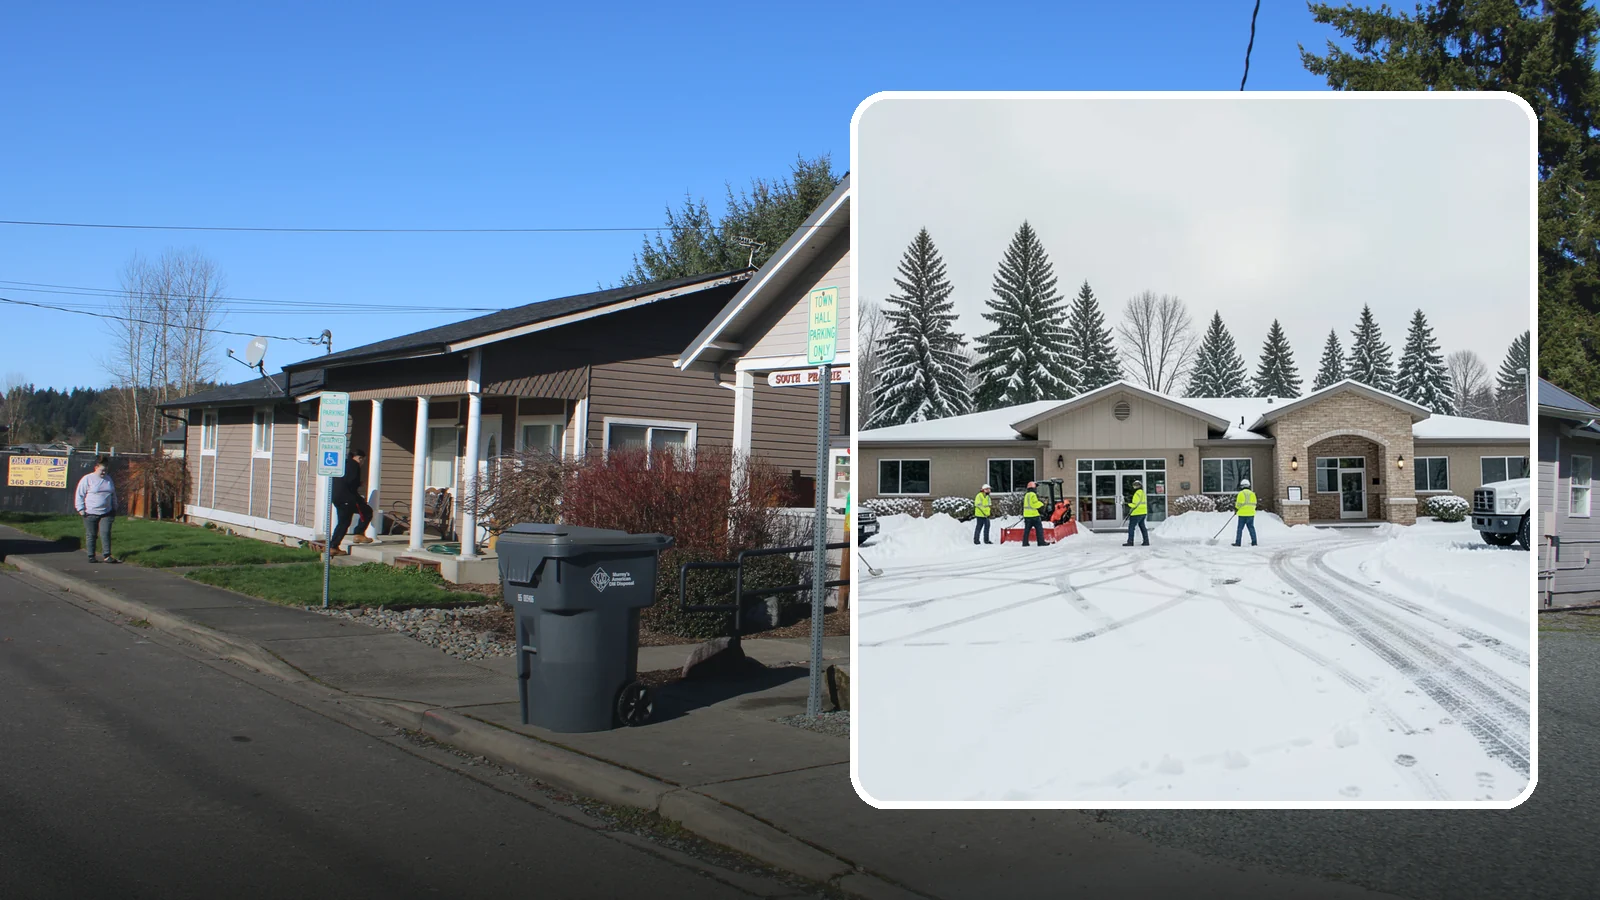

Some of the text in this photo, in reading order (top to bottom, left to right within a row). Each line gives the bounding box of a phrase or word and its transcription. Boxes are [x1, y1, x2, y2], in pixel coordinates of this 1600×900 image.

[815, 295, 833, 308] TOWN
[814, 312, 832, 324] HALL
[810, 327, 836, 341] PARKING
[813, 344, 831, 357] ONLY
[775, 373, 801, 384] SOUTH
[807, 370, 842, 382] PRIE
